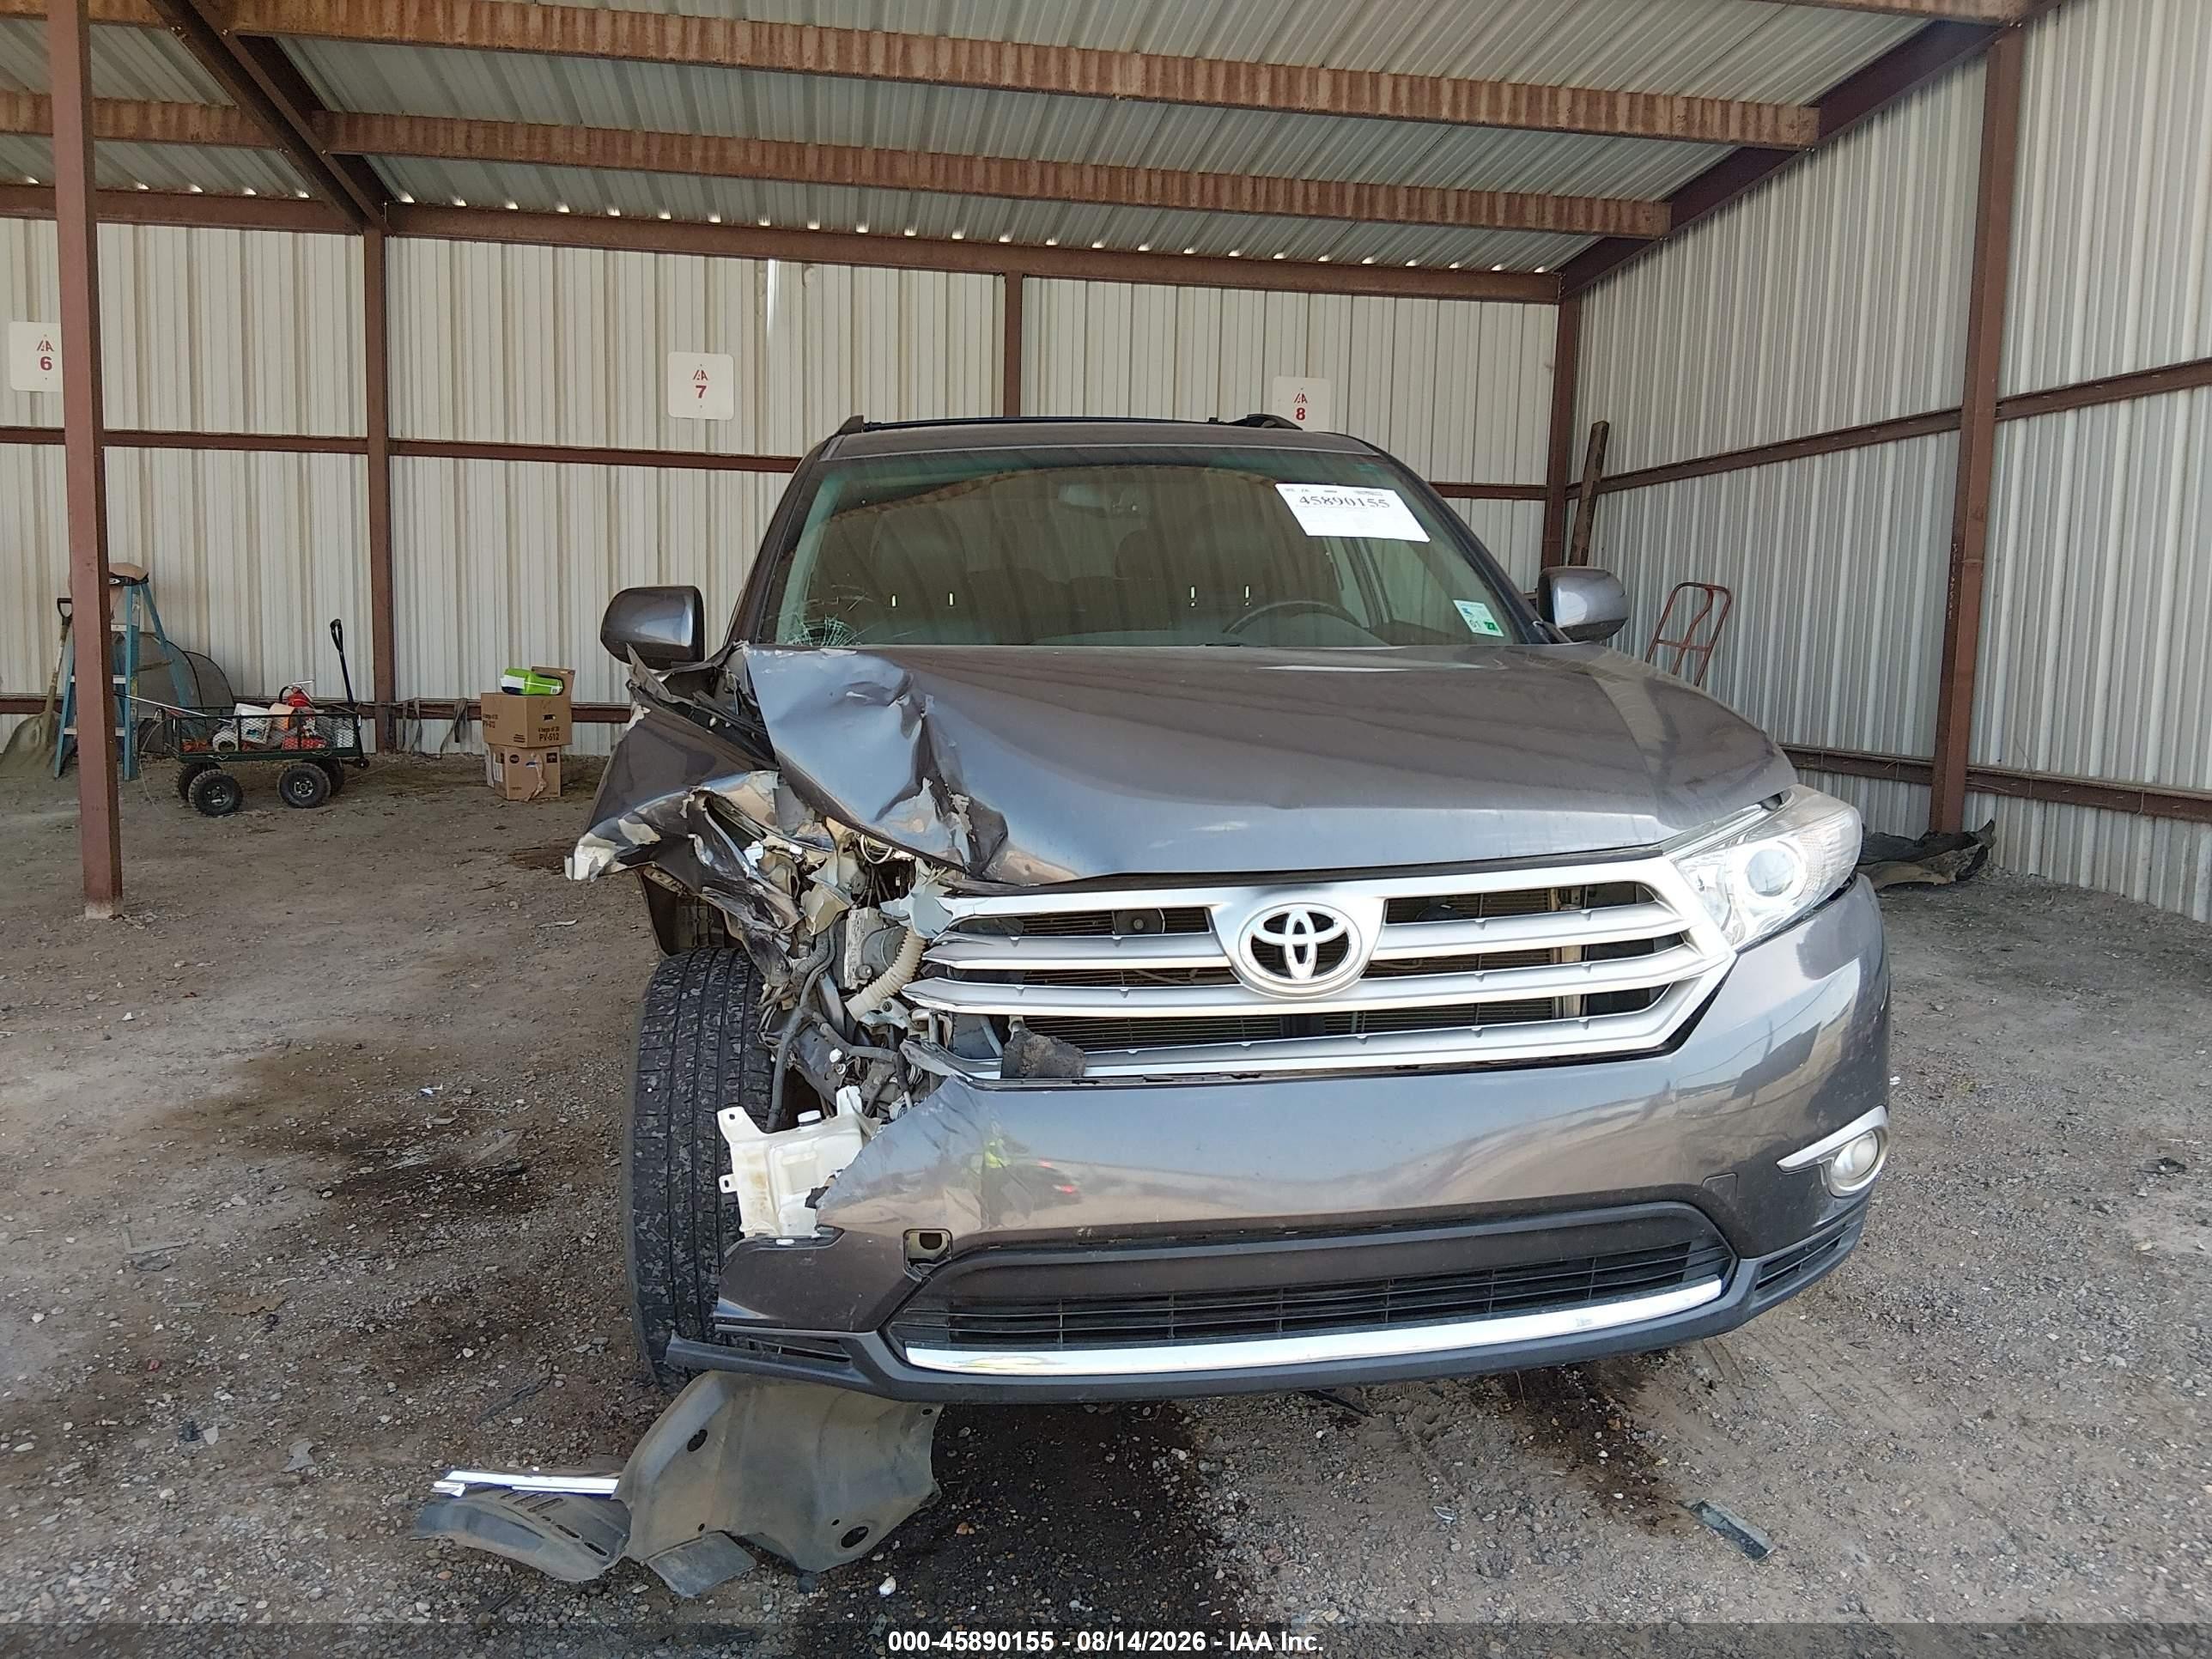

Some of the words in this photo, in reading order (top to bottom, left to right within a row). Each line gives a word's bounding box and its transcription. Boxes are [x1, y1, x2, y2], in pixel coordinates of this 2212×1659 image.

[40, 356, 52, 371] 6
[696, 385, 707, 398] 7
[1296, 407, 1305, 420] 8
[1299, 495, 1390, 508] 45890155
